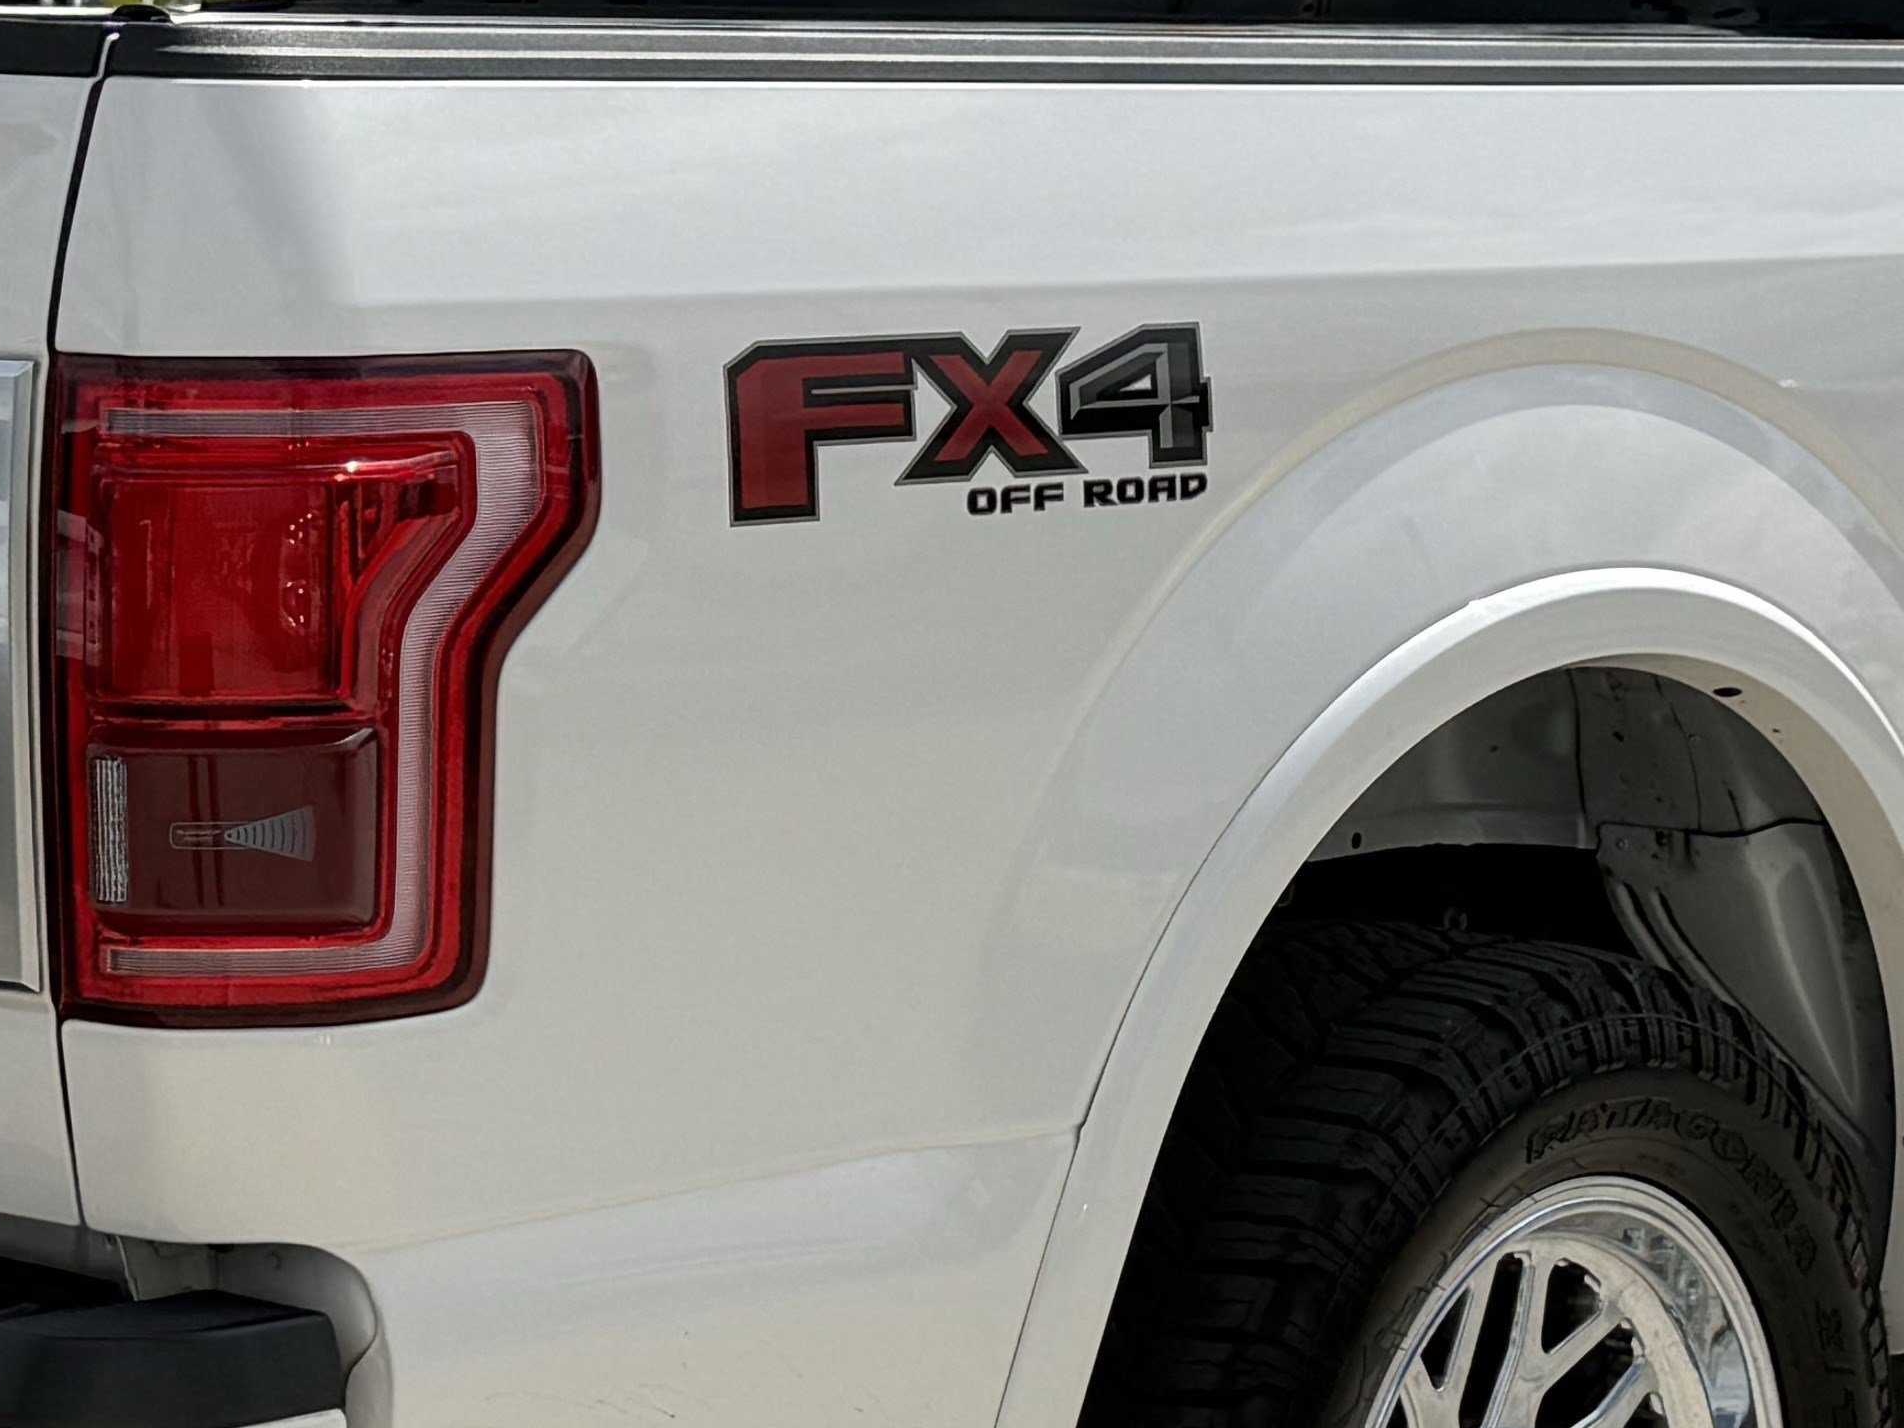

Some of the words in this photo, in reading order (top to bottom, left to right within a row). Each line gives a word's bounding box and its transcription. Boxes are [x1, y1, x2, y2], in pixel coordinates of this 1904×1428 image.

[723, 321, 1214, 528] FX4
[967, 482, 1065, 516] OFF
[1083, 473, 1208, 508] ROAD
